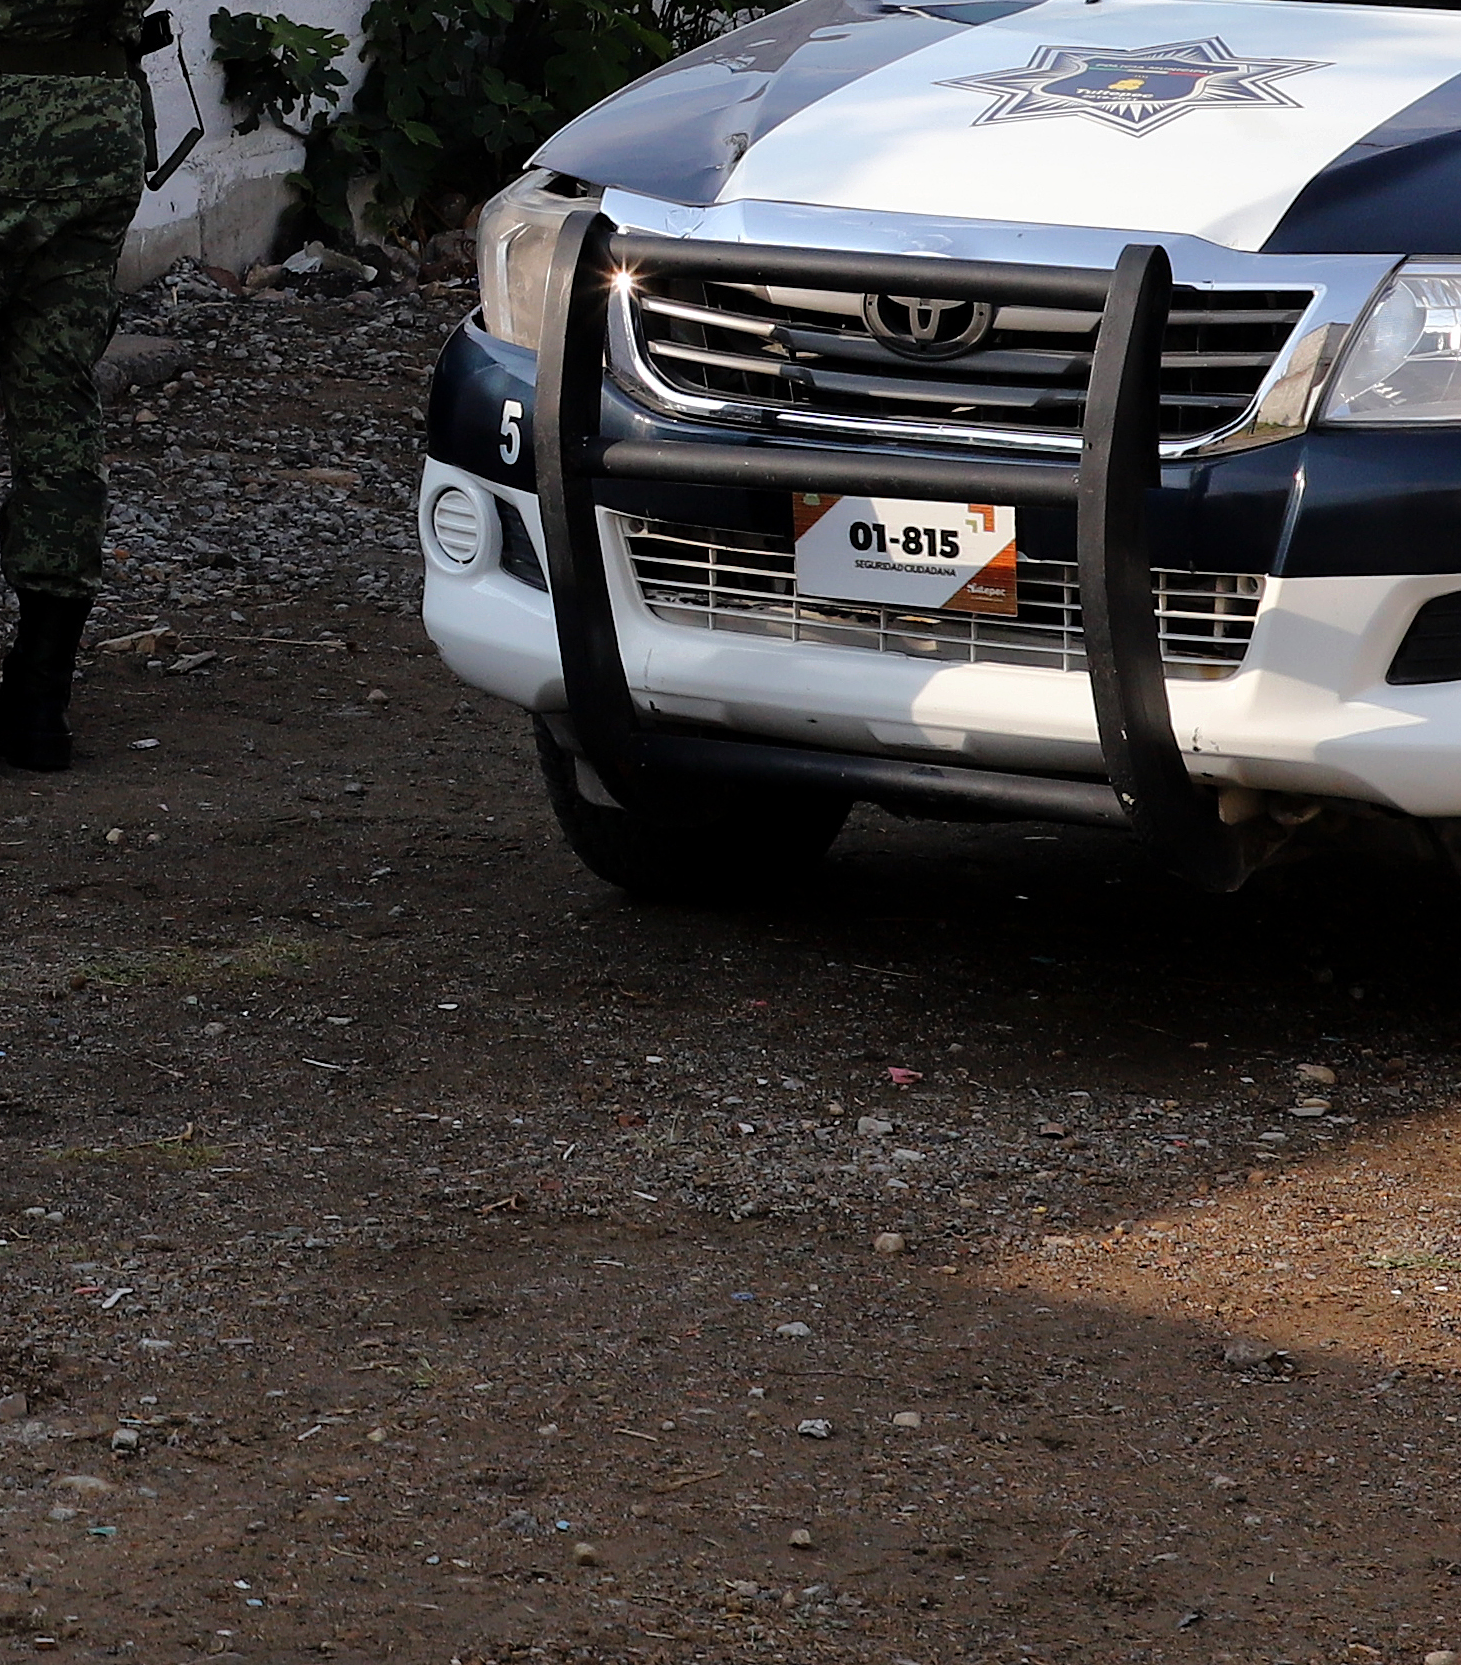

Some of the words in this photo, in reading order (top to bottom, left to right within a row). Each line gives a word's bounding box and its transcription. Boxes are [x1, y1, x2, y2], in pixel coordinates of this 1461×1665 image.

[1076, 87, 1154, 99] Tultepec
[499, 399, 523, 465] 5
[849, 521, 960, 559] 01-815
[854, 559, 904, 572] SEGURIDAD
[904, 564, 957, 577] CIUDADANA
